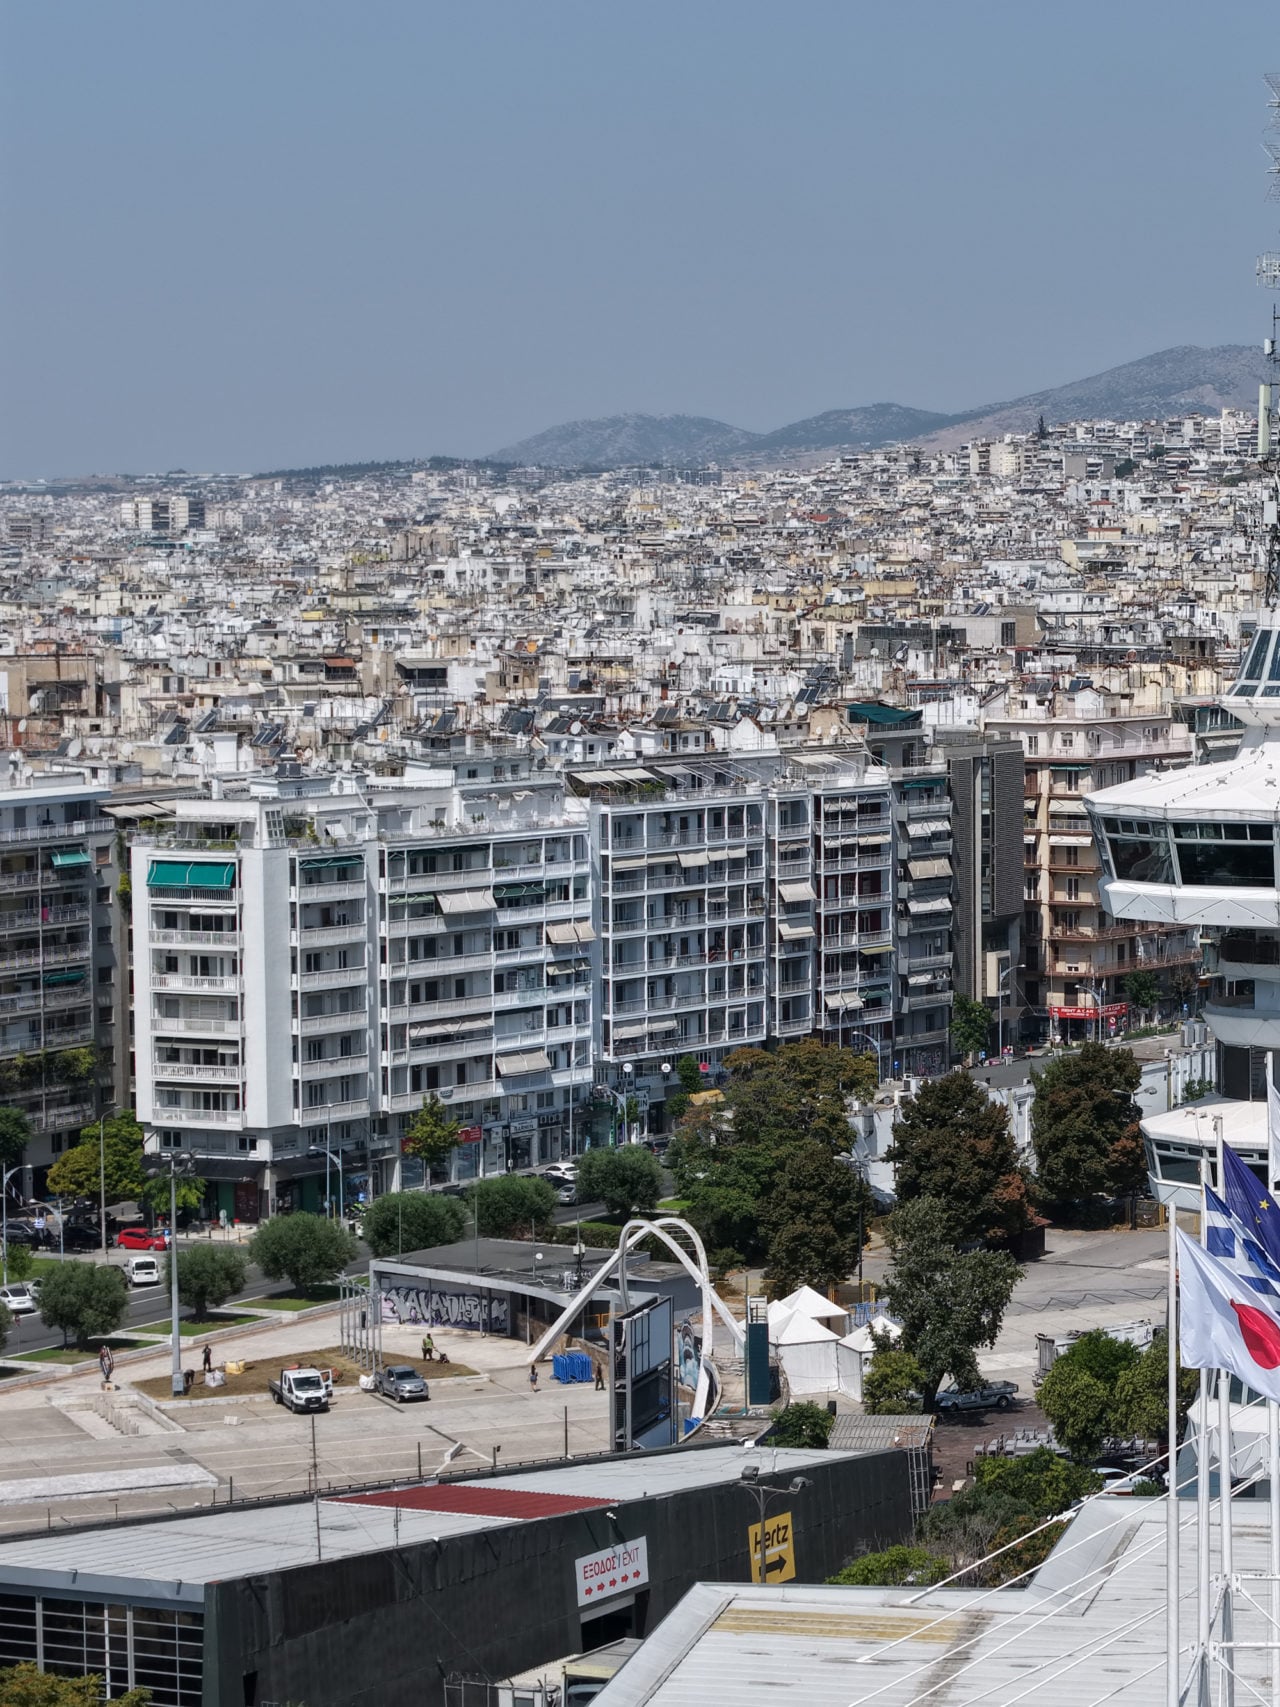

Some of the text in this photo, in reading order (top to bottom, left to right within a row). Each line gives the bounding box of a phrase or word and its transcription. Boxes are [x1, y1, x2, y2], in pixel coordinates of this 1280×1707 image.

[754, 1523, 789, 1553] Hertz
[583, 1556, 617, 1580] ΕΞΟΔΟΣ
[622, 1547, 640, 1567] EXIT
